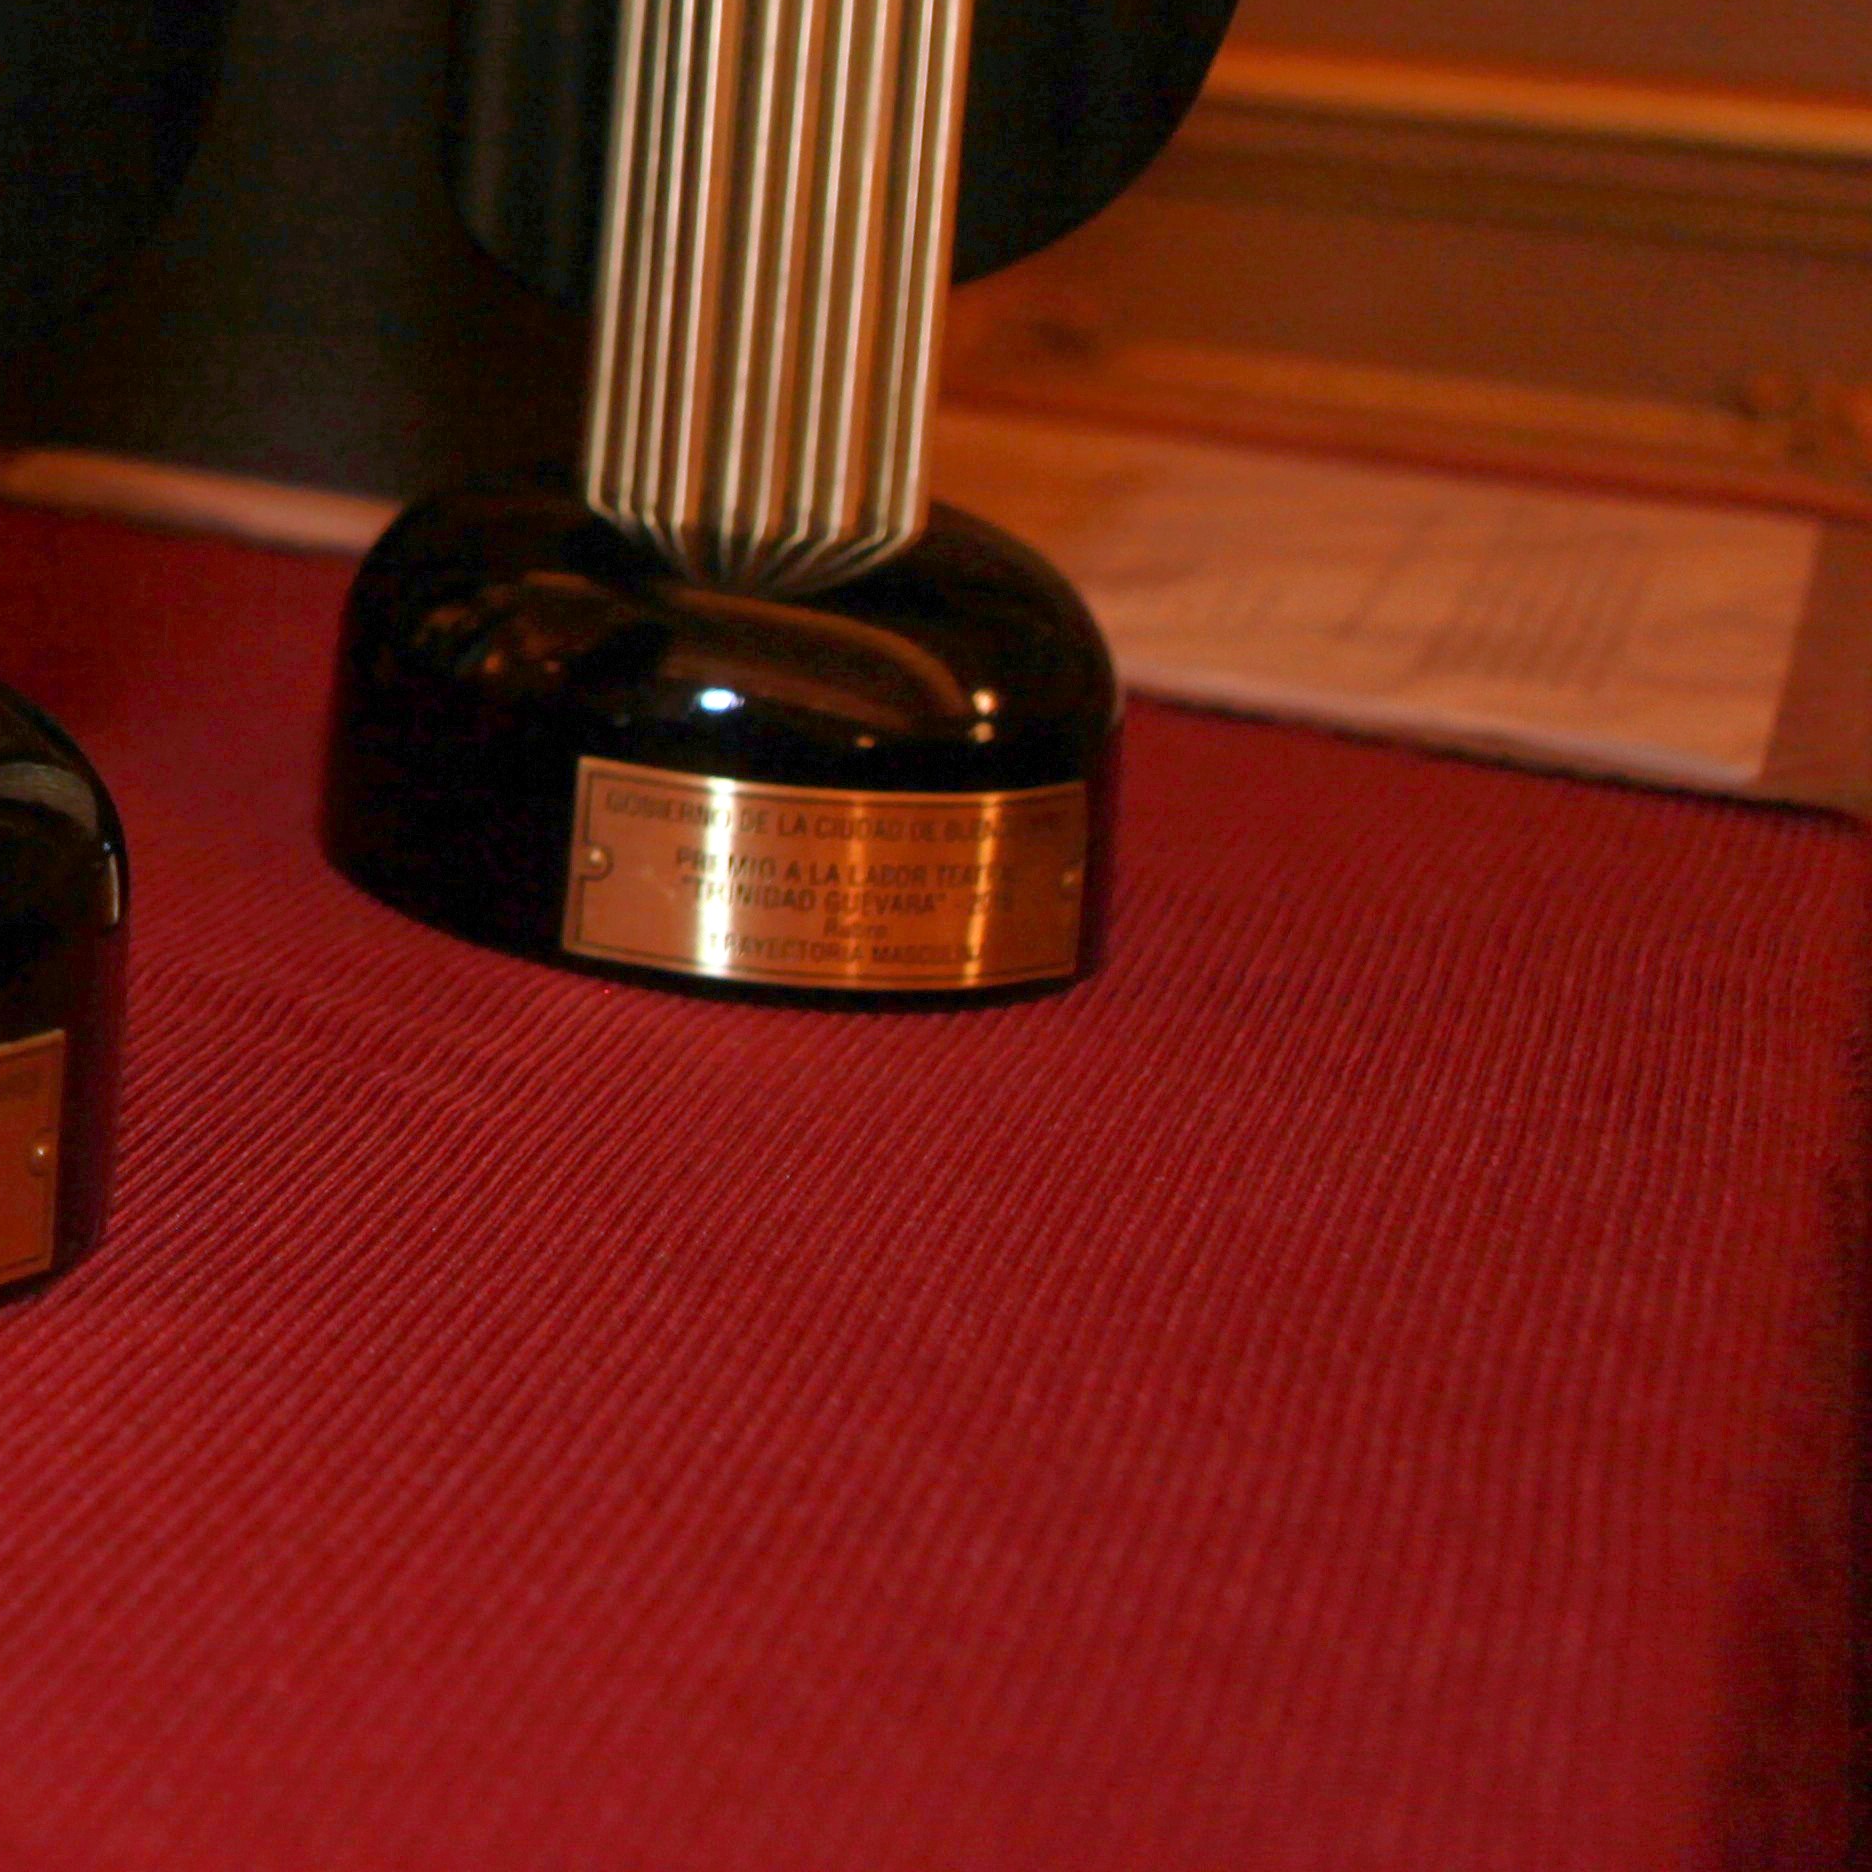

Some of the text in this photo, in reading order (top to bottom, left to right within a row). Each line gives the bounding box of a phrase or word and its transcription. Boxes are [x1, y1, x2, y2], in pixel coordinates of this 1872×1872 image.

[740, 807, 770, 835] DE
[777, 812, 807, 838] LA
[814, 815, 903, 842] CIUDAD
[783, 859, 802, 885] A
[808, 861, 841, 887] LA
[847, 863, 928, 890] LABOR
